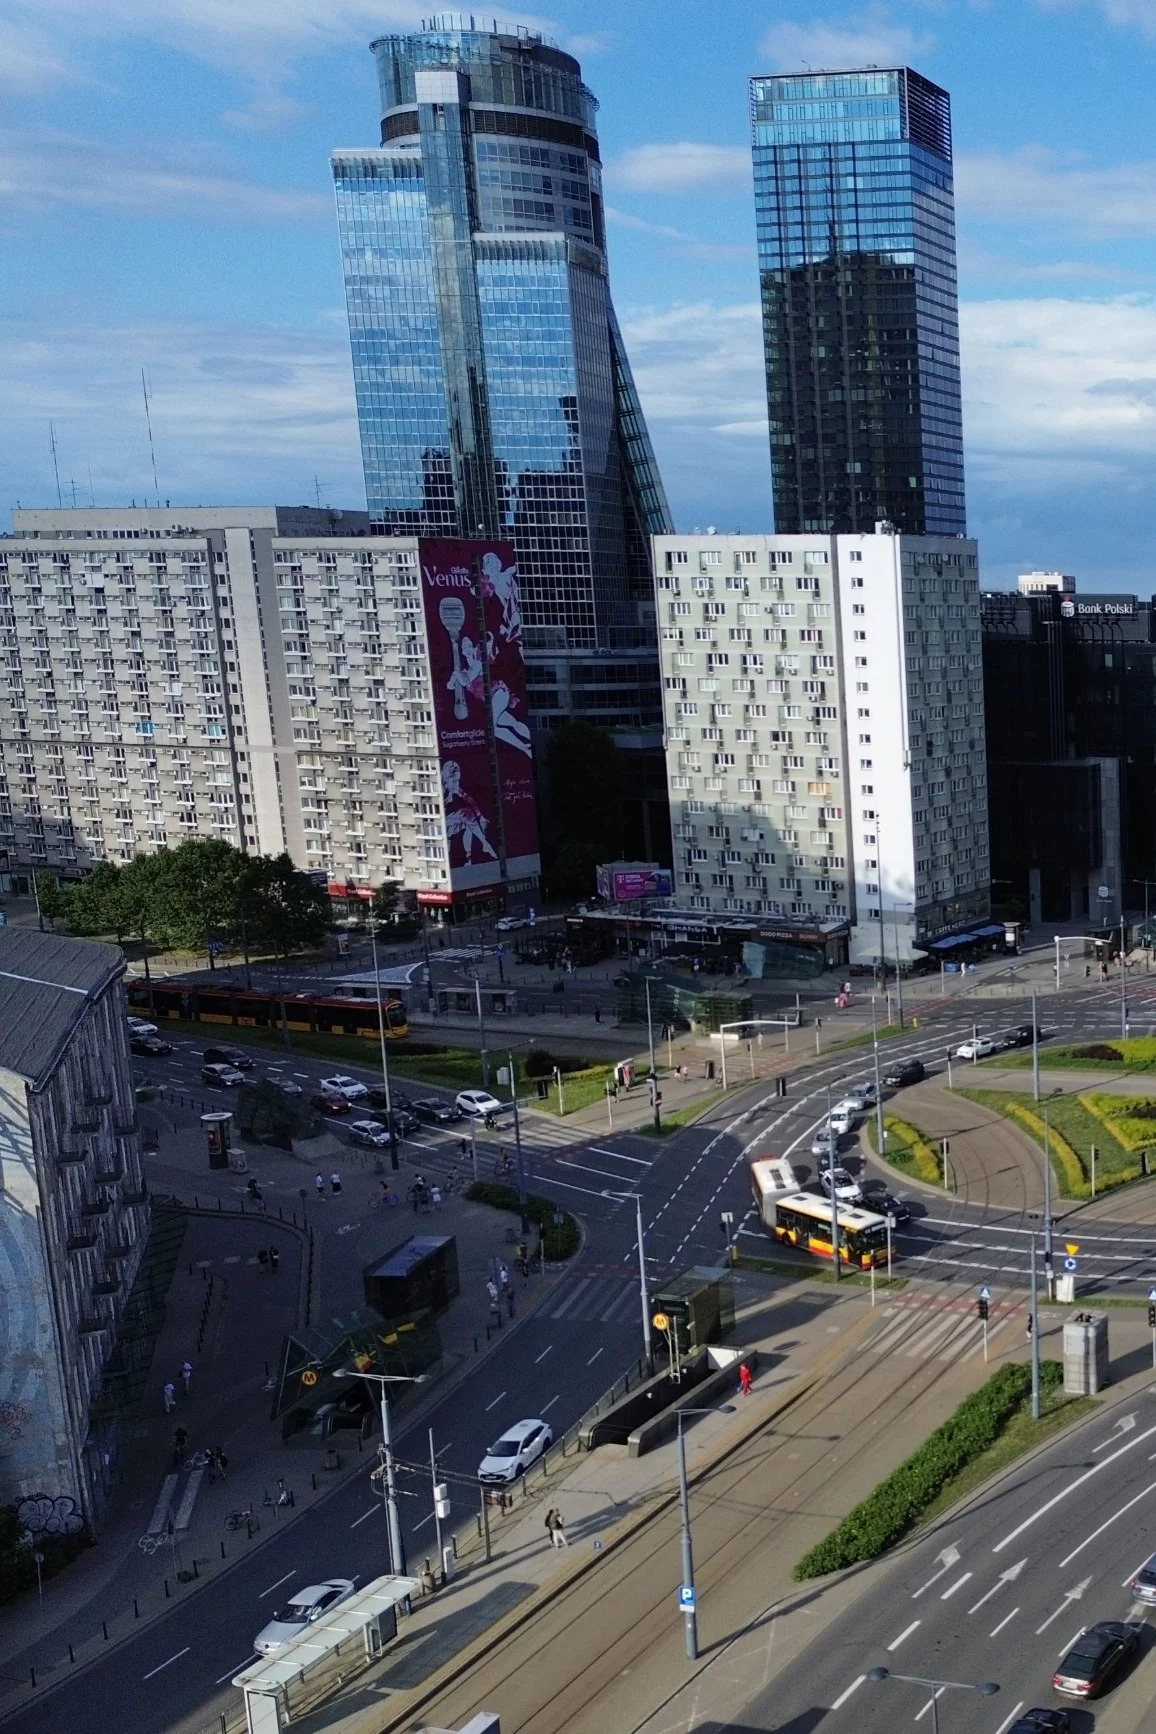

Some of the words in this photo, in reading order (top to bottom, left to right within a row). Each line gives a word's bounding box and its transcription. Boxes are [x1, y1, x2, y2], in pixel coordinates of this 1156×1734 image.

[423, 565, 472, 587] Venus
[1078, 603, 1102, 614] Bank
[1105, 603, 1133, 614] Polski
[441, 729, 485, 739] Comfortglide
[682, 1588, 692, 1600] P
